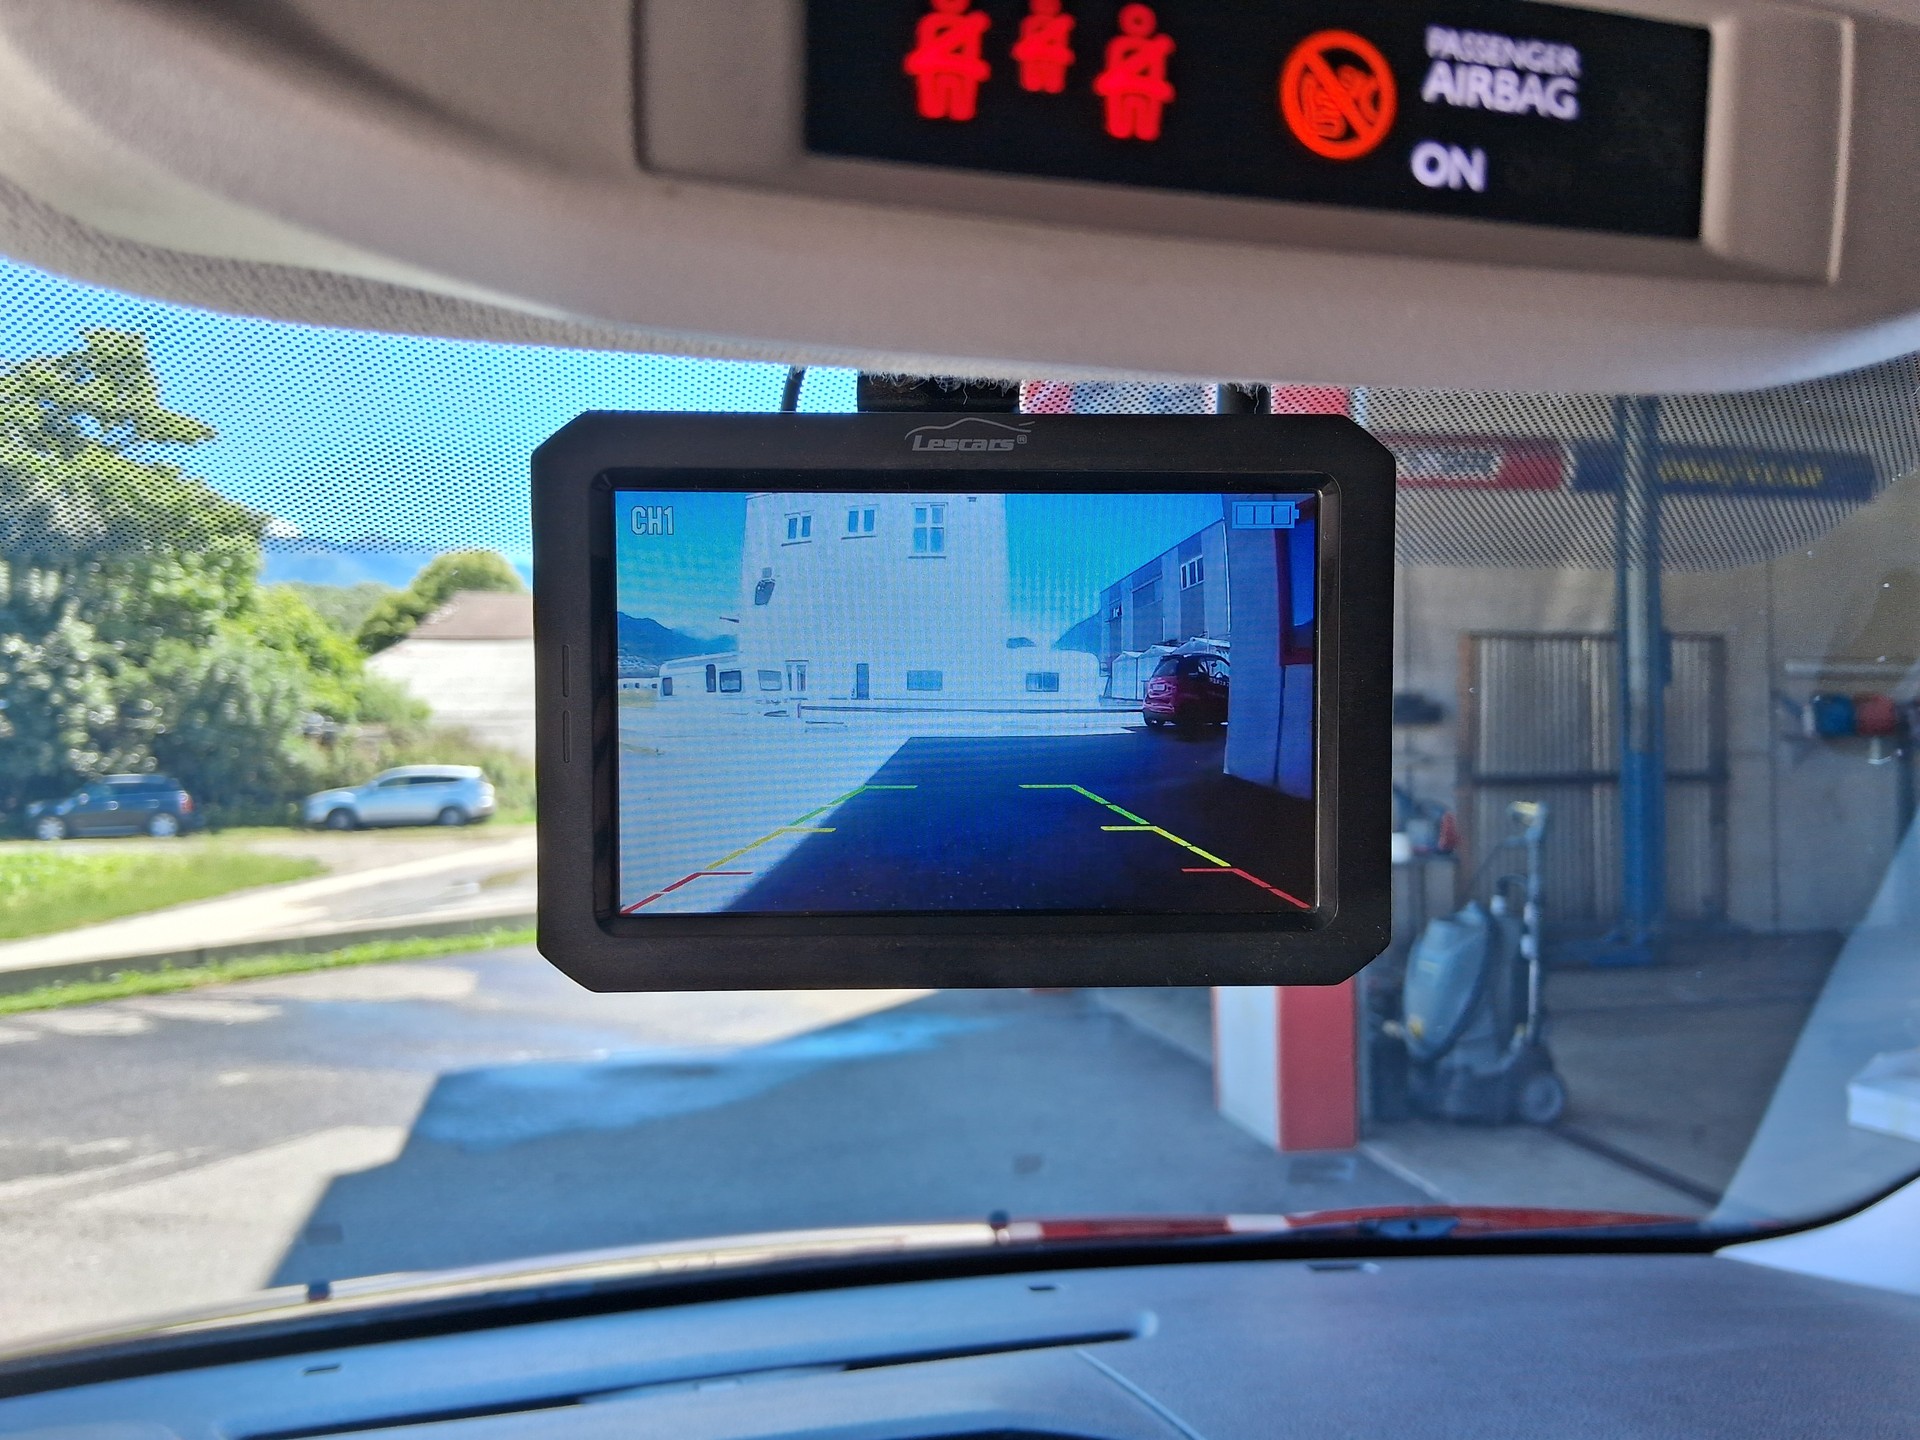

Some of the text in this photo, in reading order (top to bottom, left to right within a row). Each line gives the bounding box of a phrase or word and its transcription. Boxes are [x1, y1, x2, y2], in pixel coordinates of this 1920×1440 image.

[1426, 25, 1581, 78] PASSENGER
[1421, 60, 1579, 120] AIRBAG
[1411, 141, 1487, 192] ON
[630, 505, 675, 536] CH1
